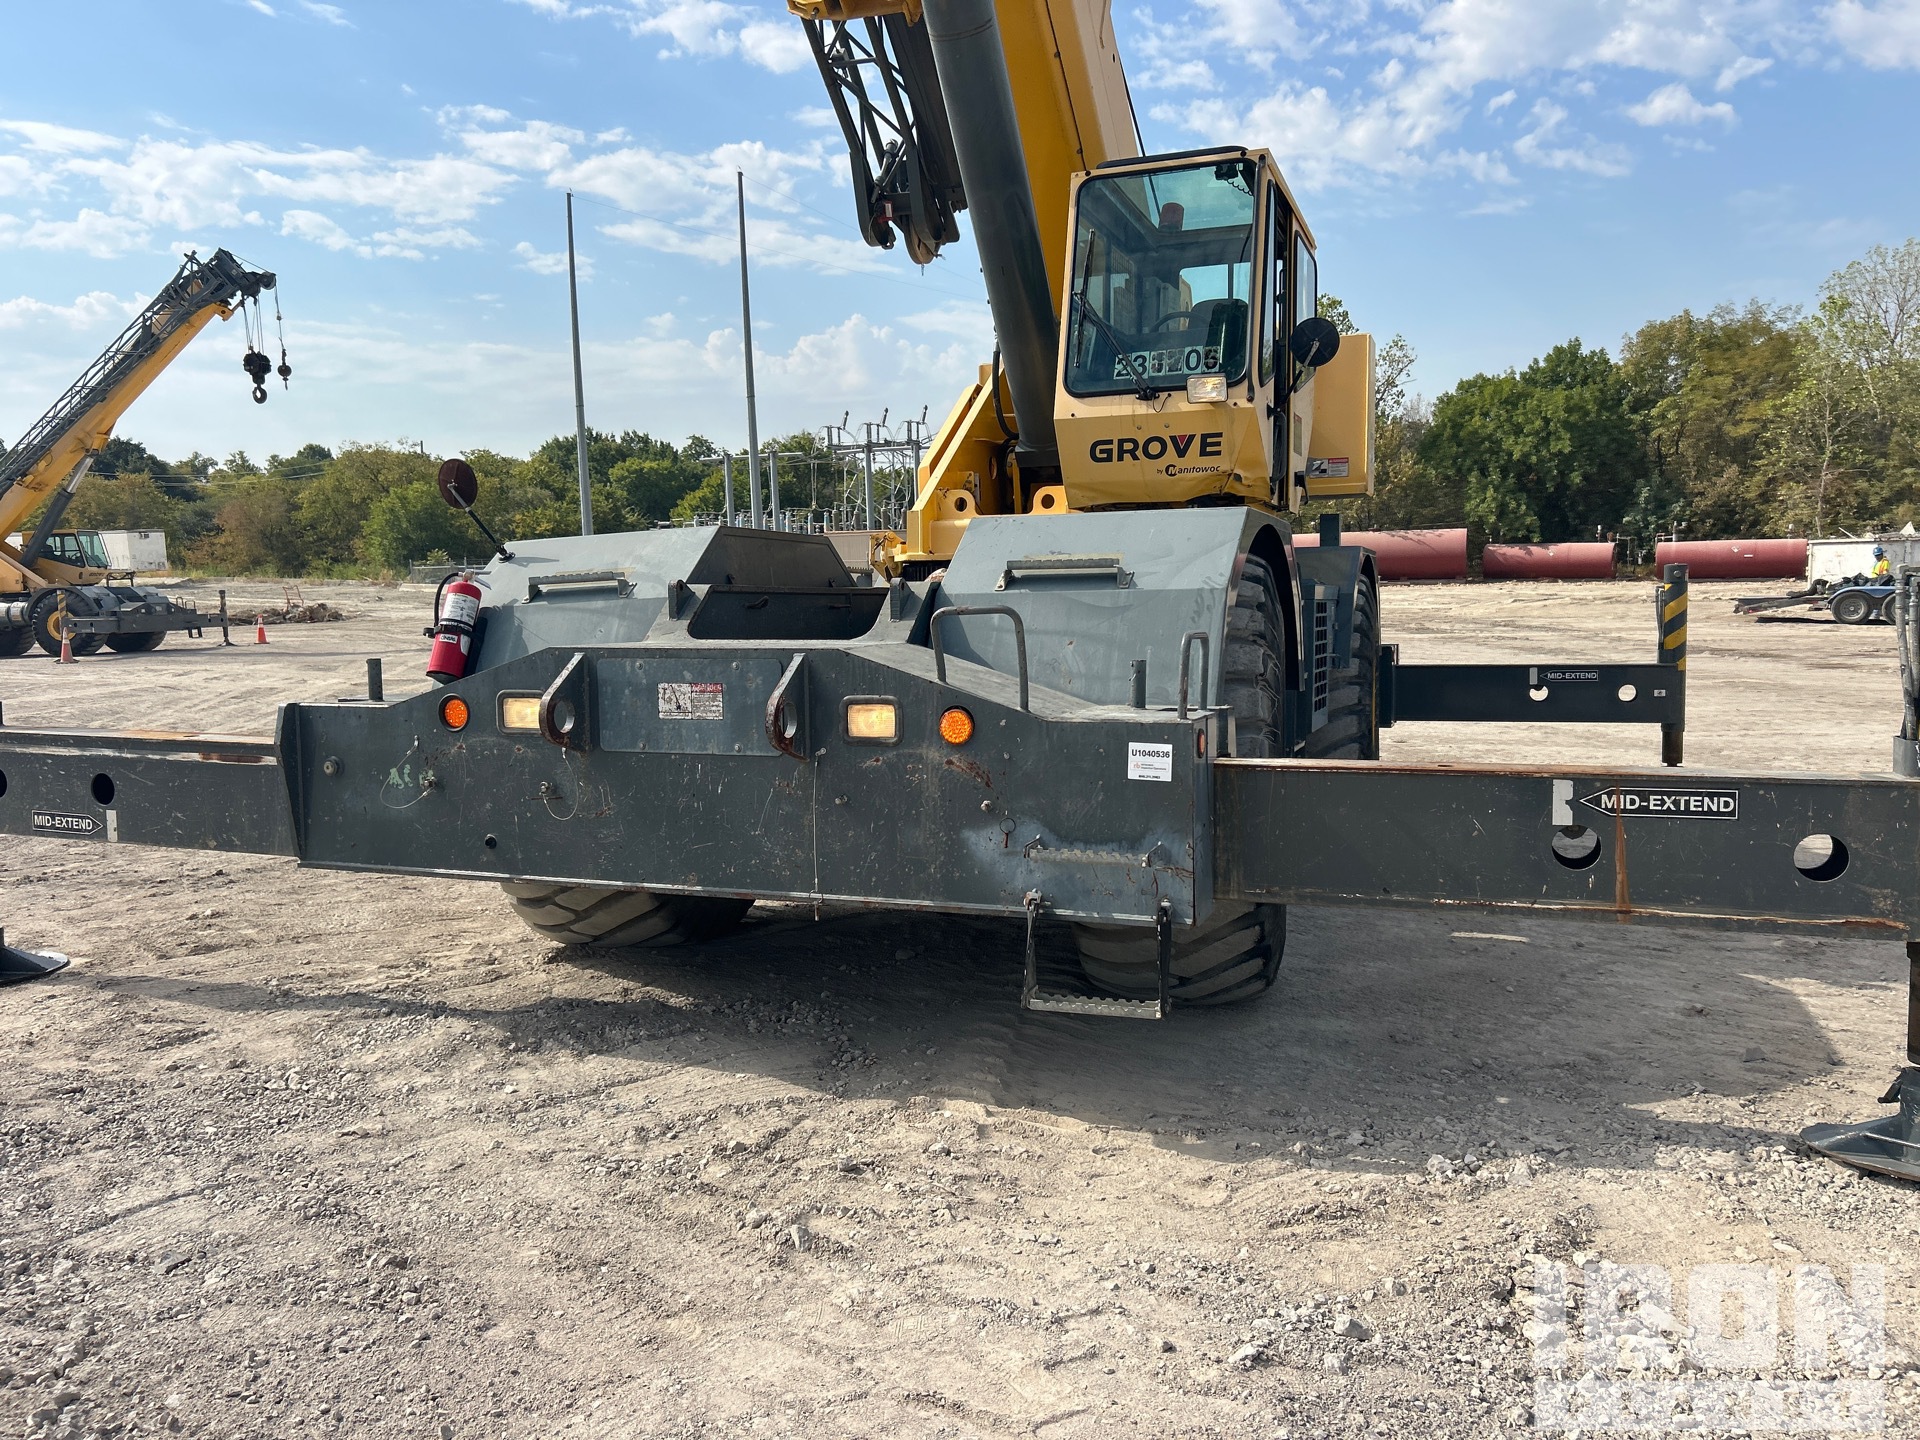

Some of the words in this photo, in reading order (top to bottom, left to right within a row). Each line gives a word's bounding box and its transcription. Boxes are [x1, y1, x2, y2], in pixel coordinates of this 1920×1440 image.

[1089, 432, 1223, 463] GROVE
[1165, 464, 1220, 477] Manitowoc
[1547, 672, 1597, 680] MID-EXTEND
[1131, 749, 1170, 758] U1040536
[1601, 794, 1735, 813] MID-EXTEND
[34, 814, 93, 830] MID-EXTEND
